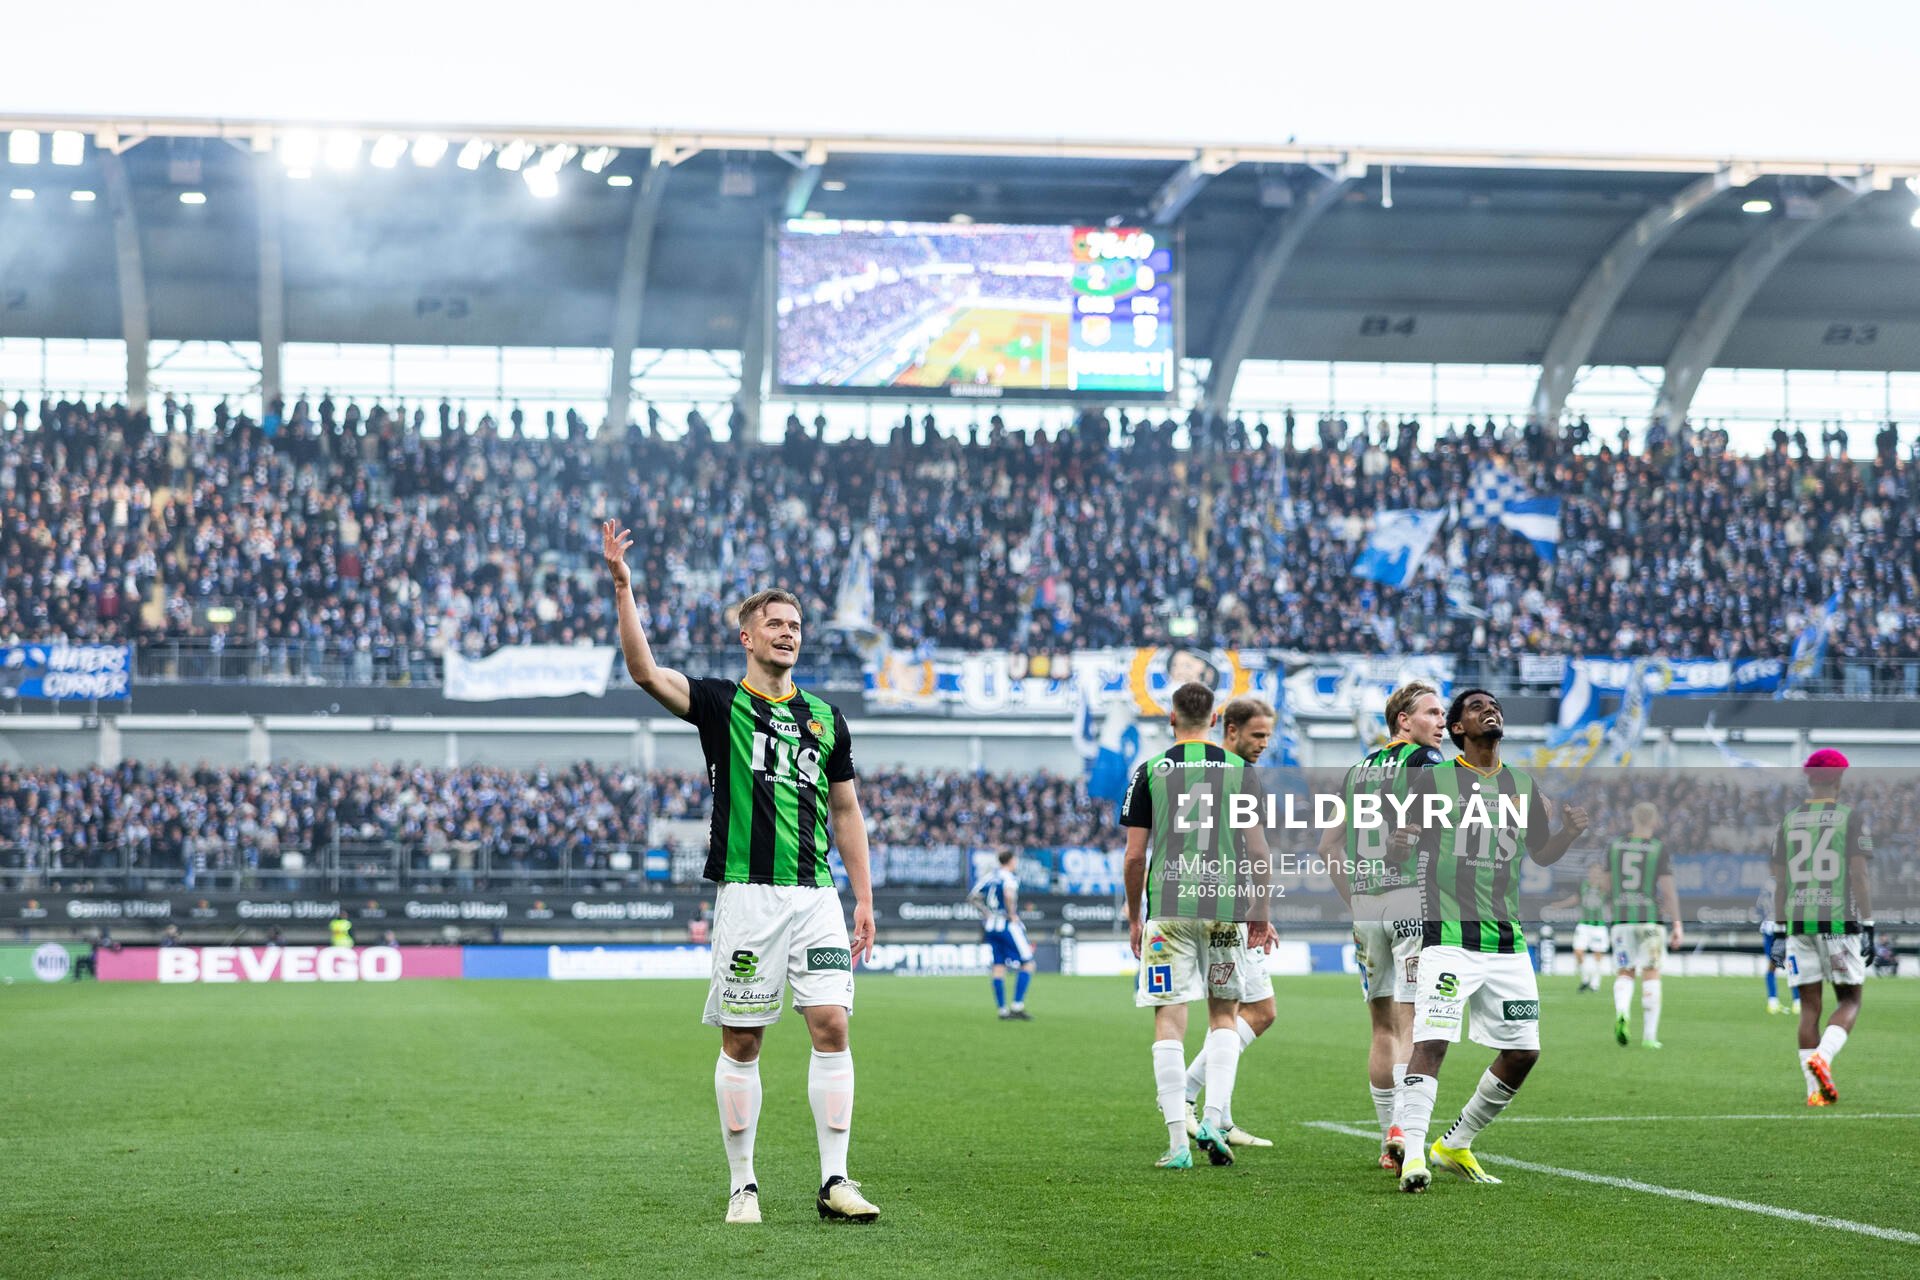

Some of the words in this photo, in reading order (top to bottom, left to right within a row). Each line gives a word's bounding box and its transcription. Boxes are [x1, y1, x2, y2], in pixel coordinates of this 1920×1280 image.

[42, 671, 128, 698] CORNER
[770, 721, 798, 733] SKAB
[1175, 758, 1237, 770] macforum
[1121, 771, 1141, 817] stadium
[1173, 782, 1212, 851] 4
[1786, 827, 1841, 883] 26
[1154, 870, 1228, 884] WELLNESS
[1621, 852, 1644, 890] 5
[1210, 930, 1238, 940] GOOD
[1397, 927, 1423, 938] ADVI
[158, 946, 402, 983] BEVEGO
[863, 944, 994, 971] OPTIMER
[741, 989, 779, 1000] Ekstrand
